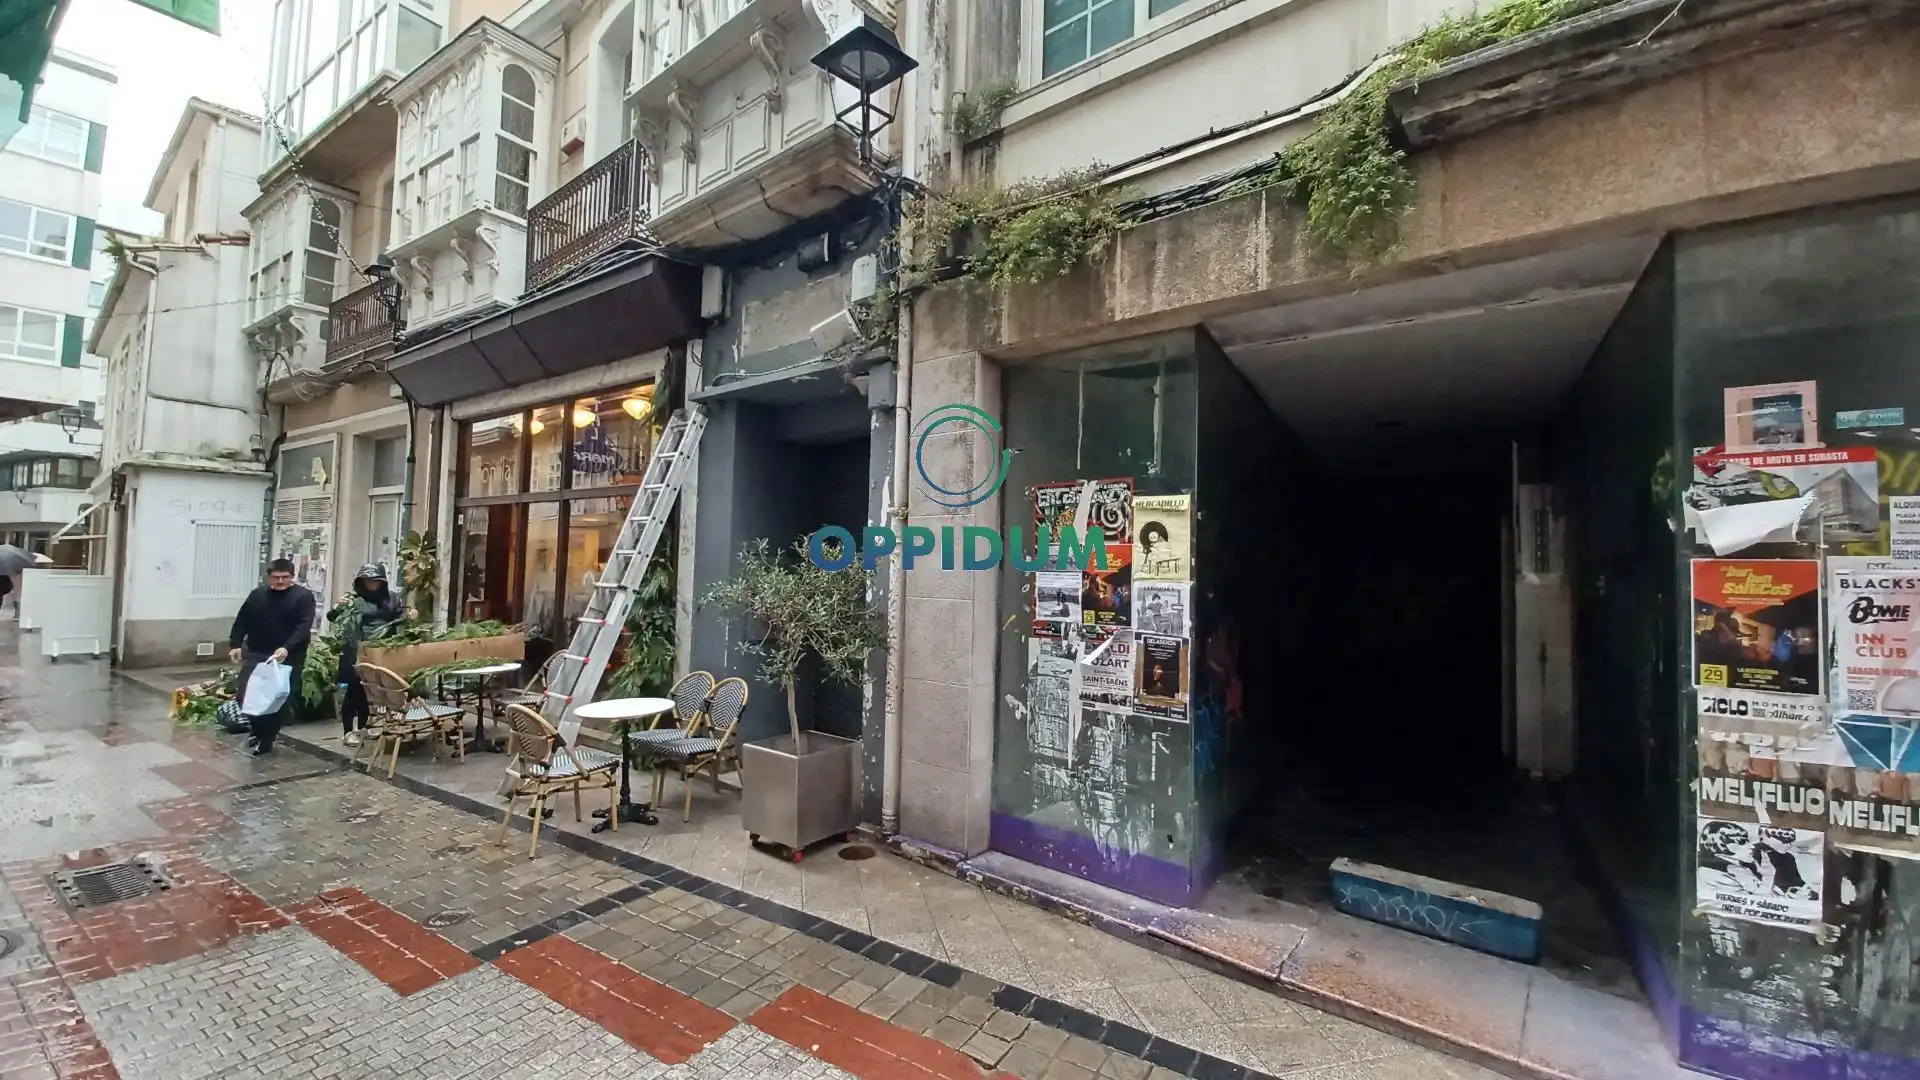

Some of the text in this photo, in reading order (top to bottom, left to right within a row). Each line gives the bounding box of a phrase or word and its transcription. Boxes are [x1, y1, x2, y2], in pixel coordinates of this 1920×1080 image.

[1808, 452, 1848, 462] SUBASTA
[1134, 499, 1185, 508] MERCADILLO
[1840, 578, 1920, 590] BLACKS
[1855, 633, 1885, 645] INN
[1856, 646, 1908, 658] CLUB
[1704, 668, 1723, 681] 29
[1702, 776, 1825, 816] MELIFLUO
[1715, 892, 1748, 906] VIERNES
